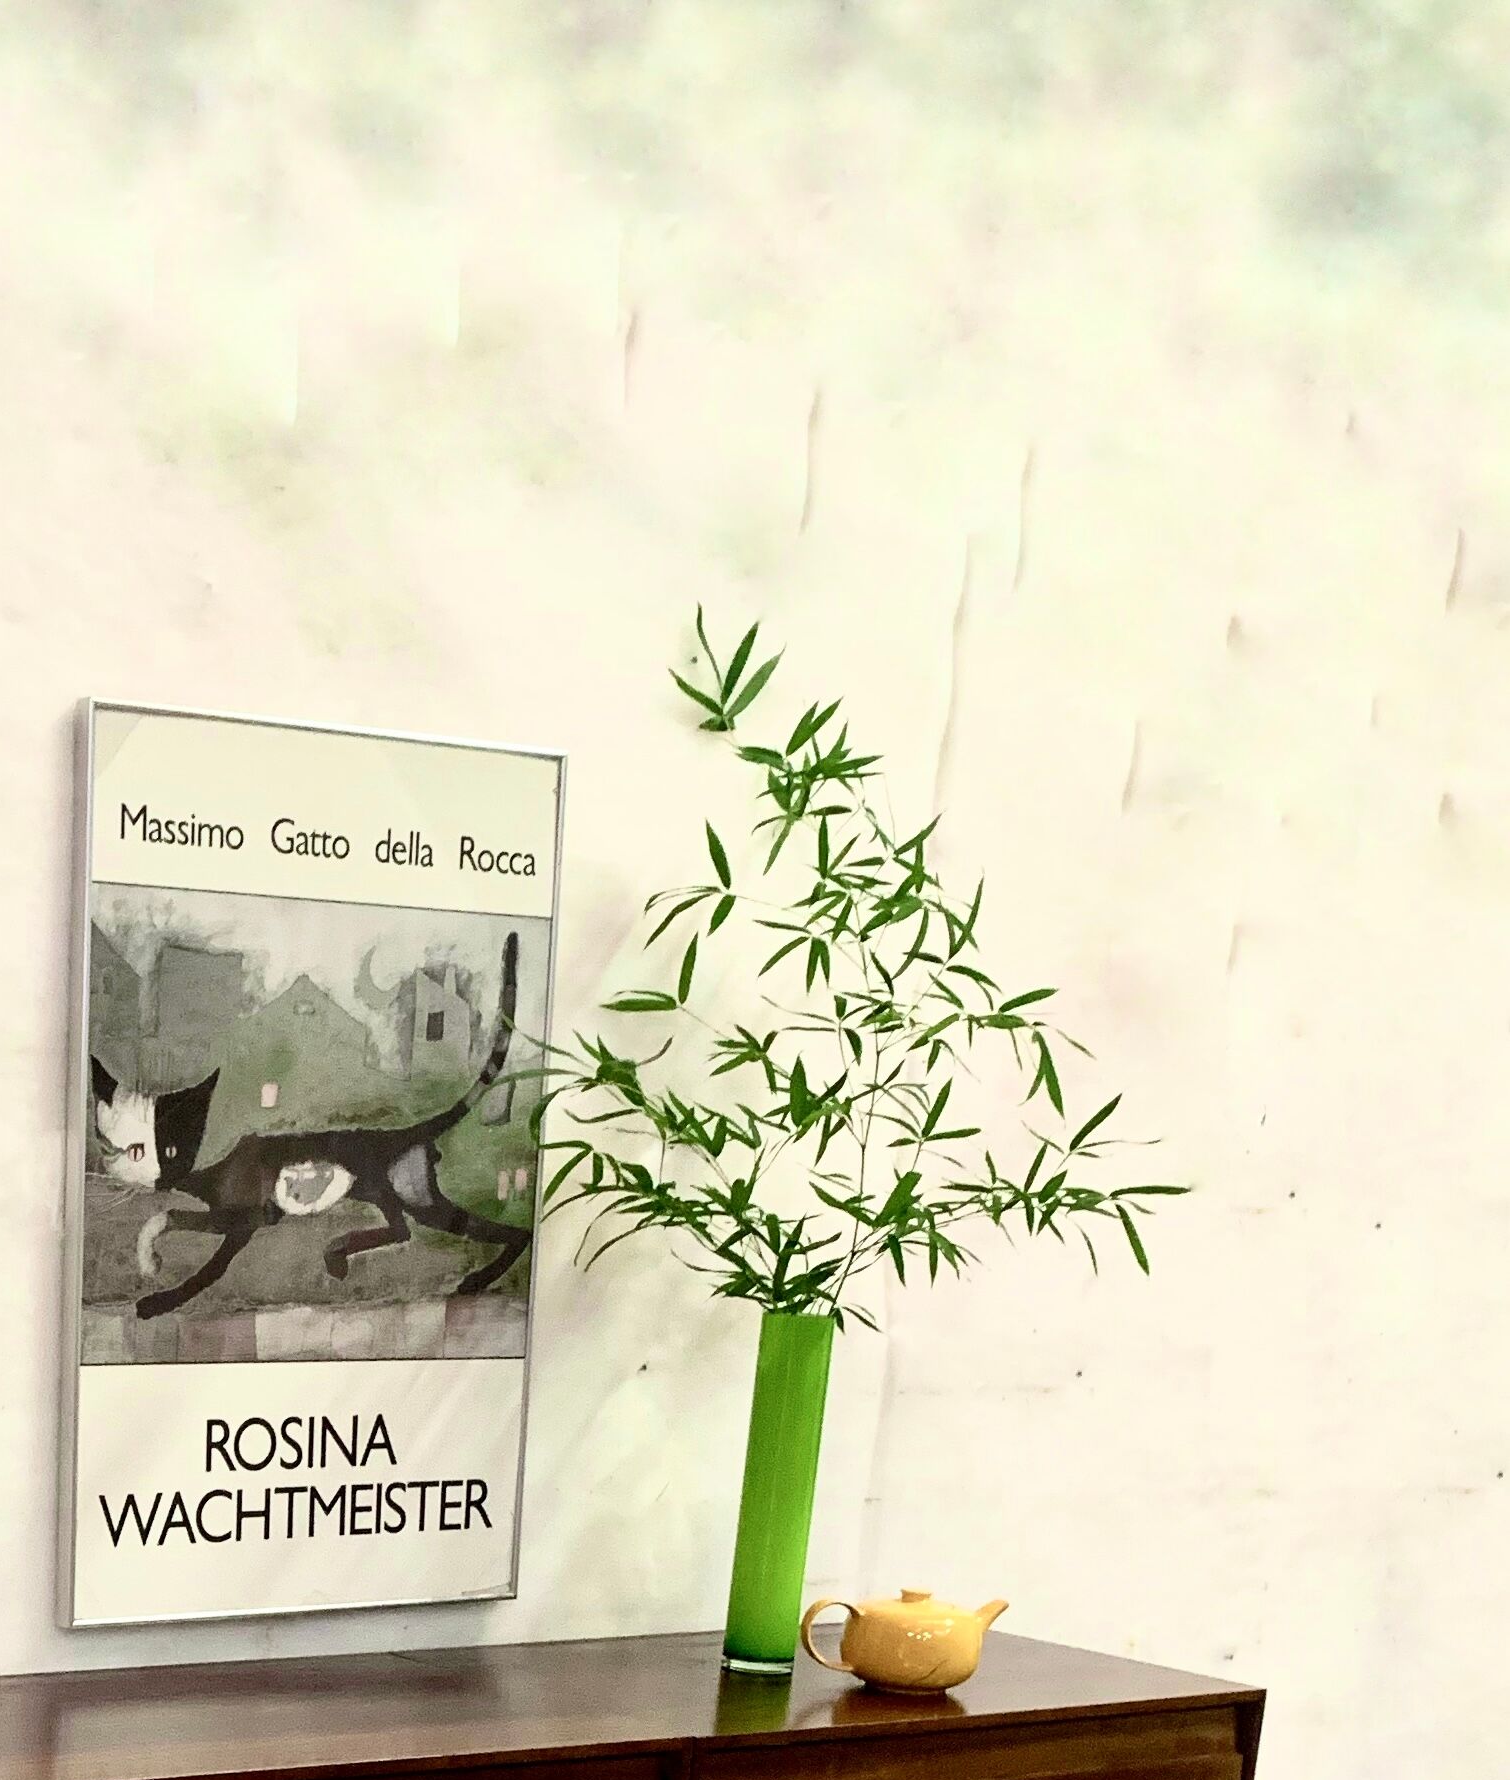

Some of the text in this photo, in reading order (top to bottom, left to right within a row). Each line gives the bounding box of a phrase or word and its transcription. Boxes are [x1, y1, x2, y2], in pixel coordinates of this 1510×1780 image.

[119, 802, 536, 877] Massimo Gatto della Rocca
[205, 1413, 398, 1473] ROSINA
[98, 1478, 493, 1548] WACHTMEISTER
